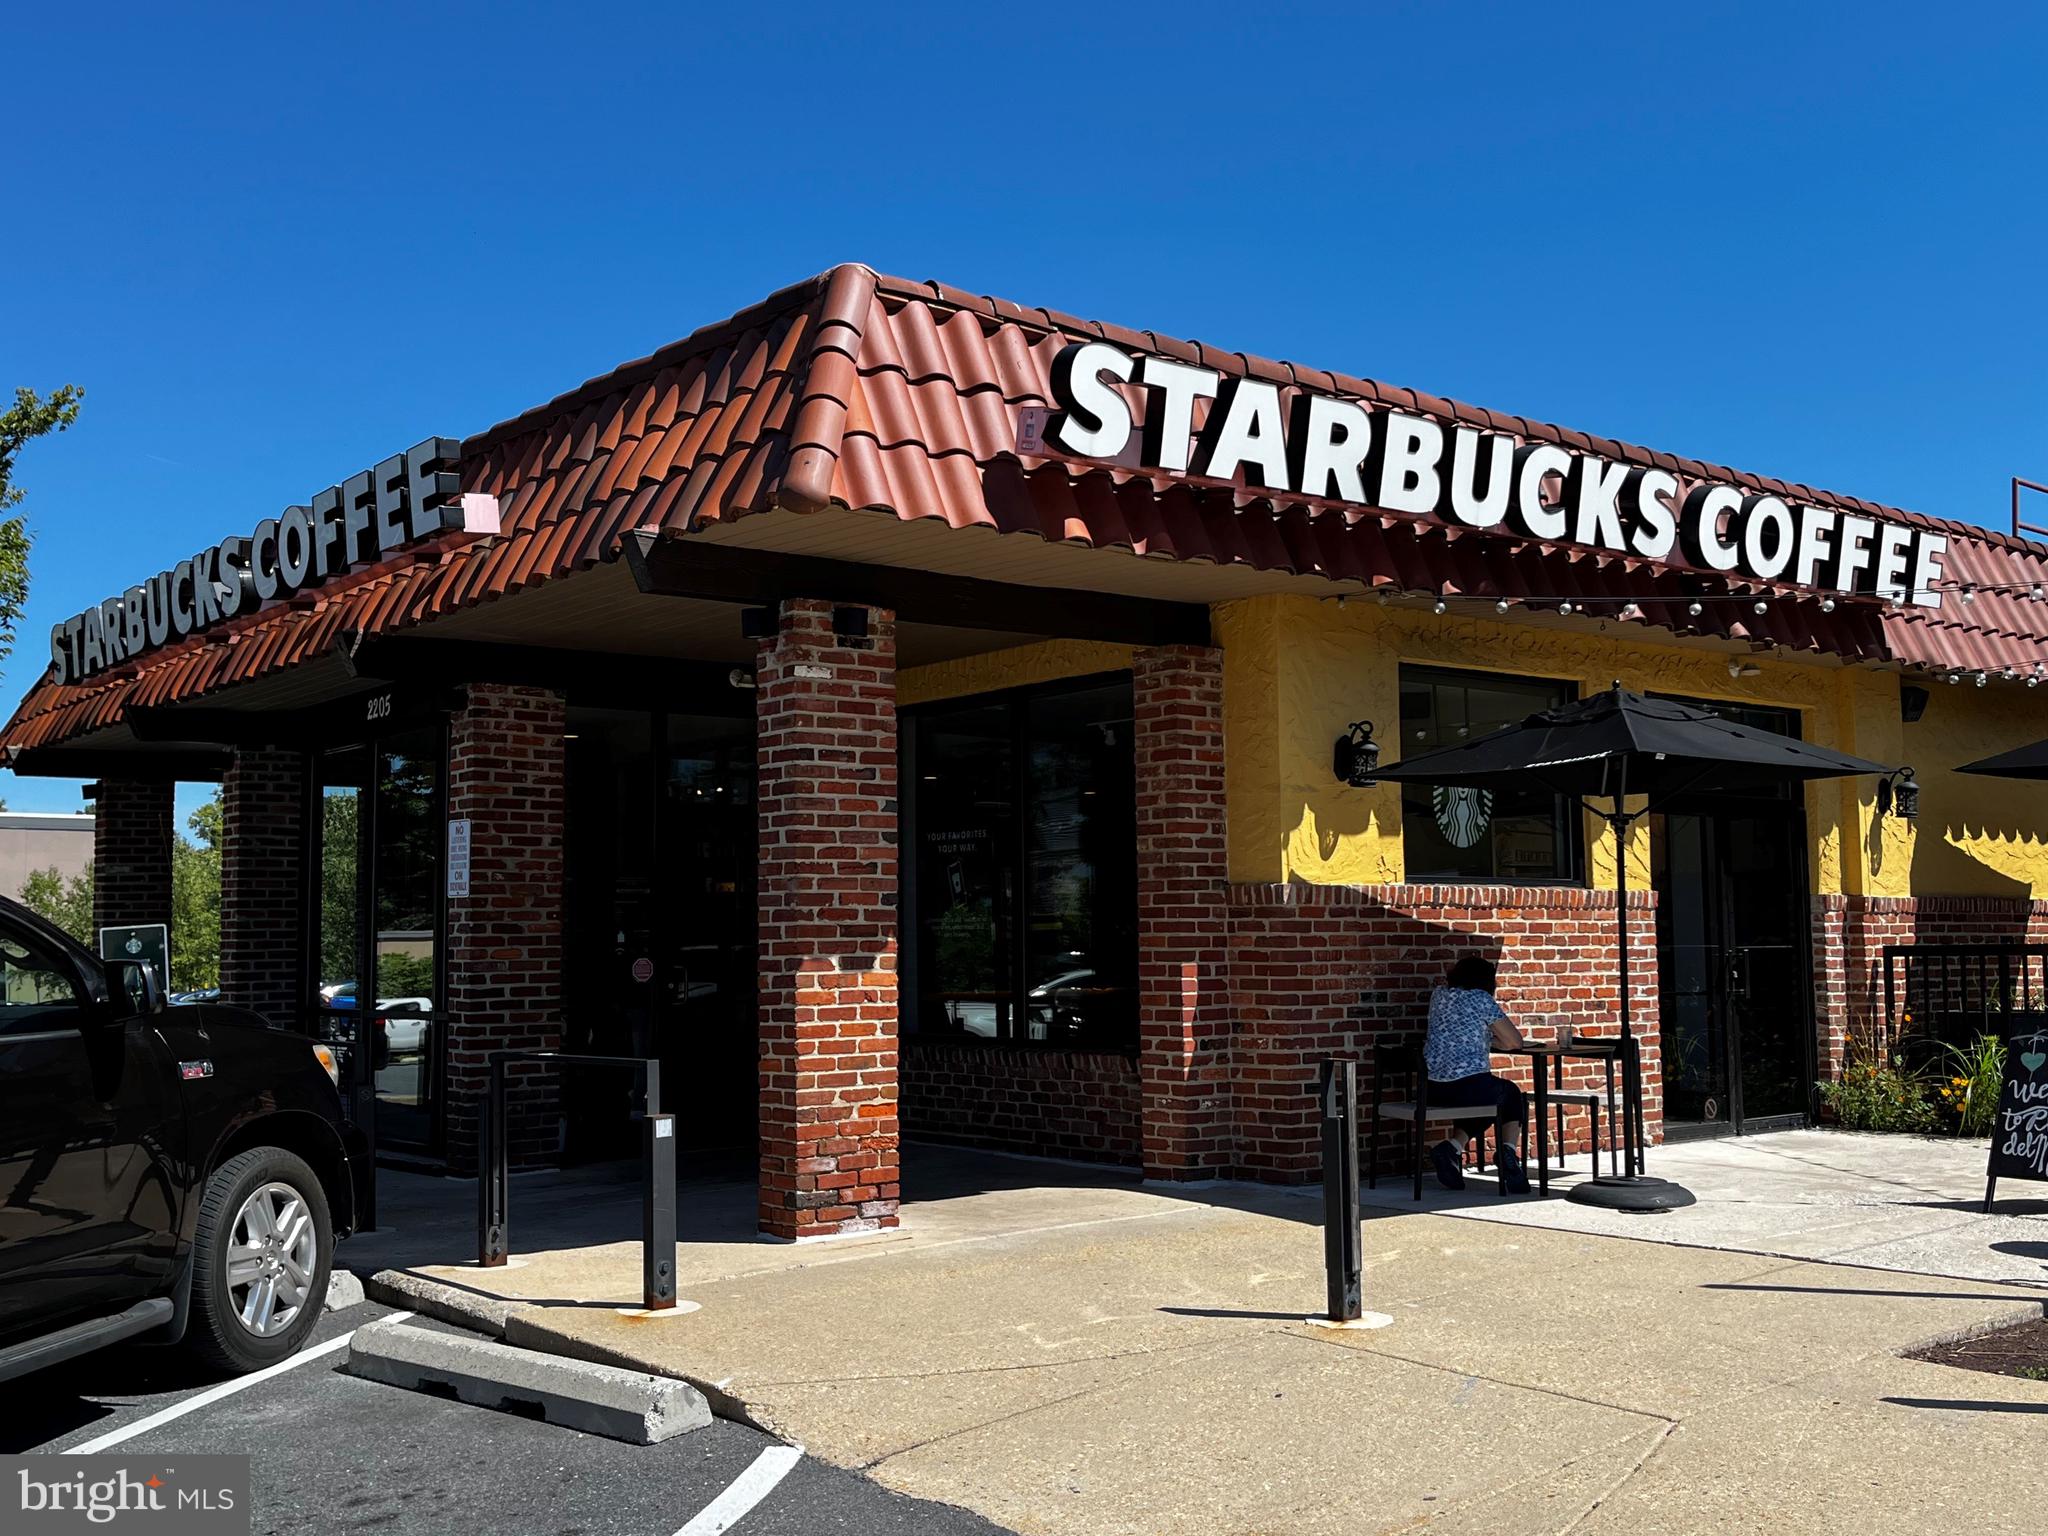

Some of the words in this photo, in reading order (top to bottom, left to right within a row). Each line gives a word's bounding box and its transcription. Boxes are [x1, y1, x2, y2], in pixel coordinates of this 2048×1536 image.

[1058, 342, 1678, 560] STARBUCKS
[1698, 485, 1948, 609] COFFEE
[51, 536, 242, 686] STARBUCKS
[251, 436, 442, 600] COFFEE
[367, 693, 391, 720] 2205
[455, 825, 464, 836] NO
[927, 832, 946, 841] YOUR
[948, 829, 987, 841] FAVORITES
[938, 844, 957, 853] YOUR
